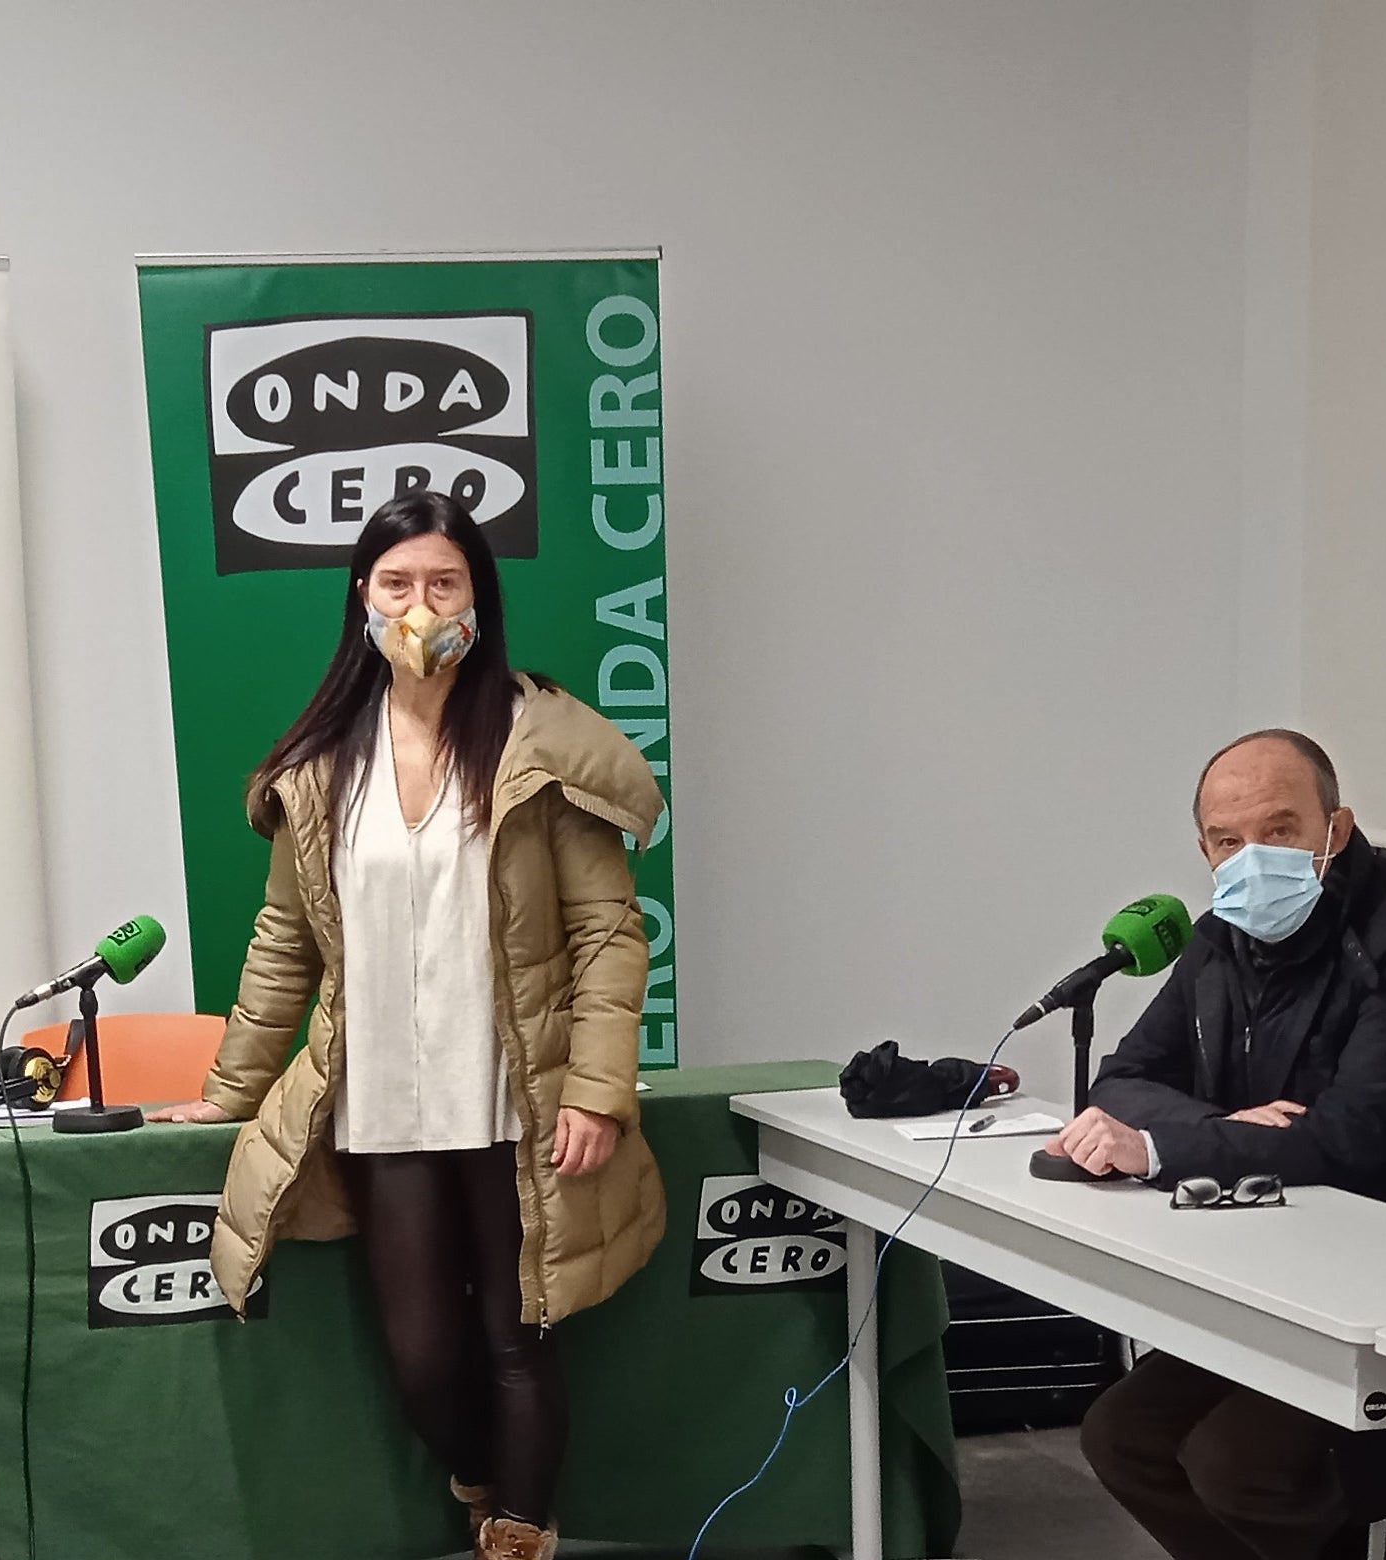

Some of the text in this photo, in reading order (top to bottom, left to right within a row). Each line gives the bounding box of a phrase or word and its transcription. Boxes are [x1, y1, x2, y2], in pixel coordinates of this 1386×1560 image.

[253, 368, 482, 423] ONDA
[585, 294, 663, 551] CERO
[720, 1198, 833, 1225] ONDA
[114, 1221, 210, 1250] OND
[721, 1244, 831, 1274] CERO
[122, 1270, 212, 1304] CER
